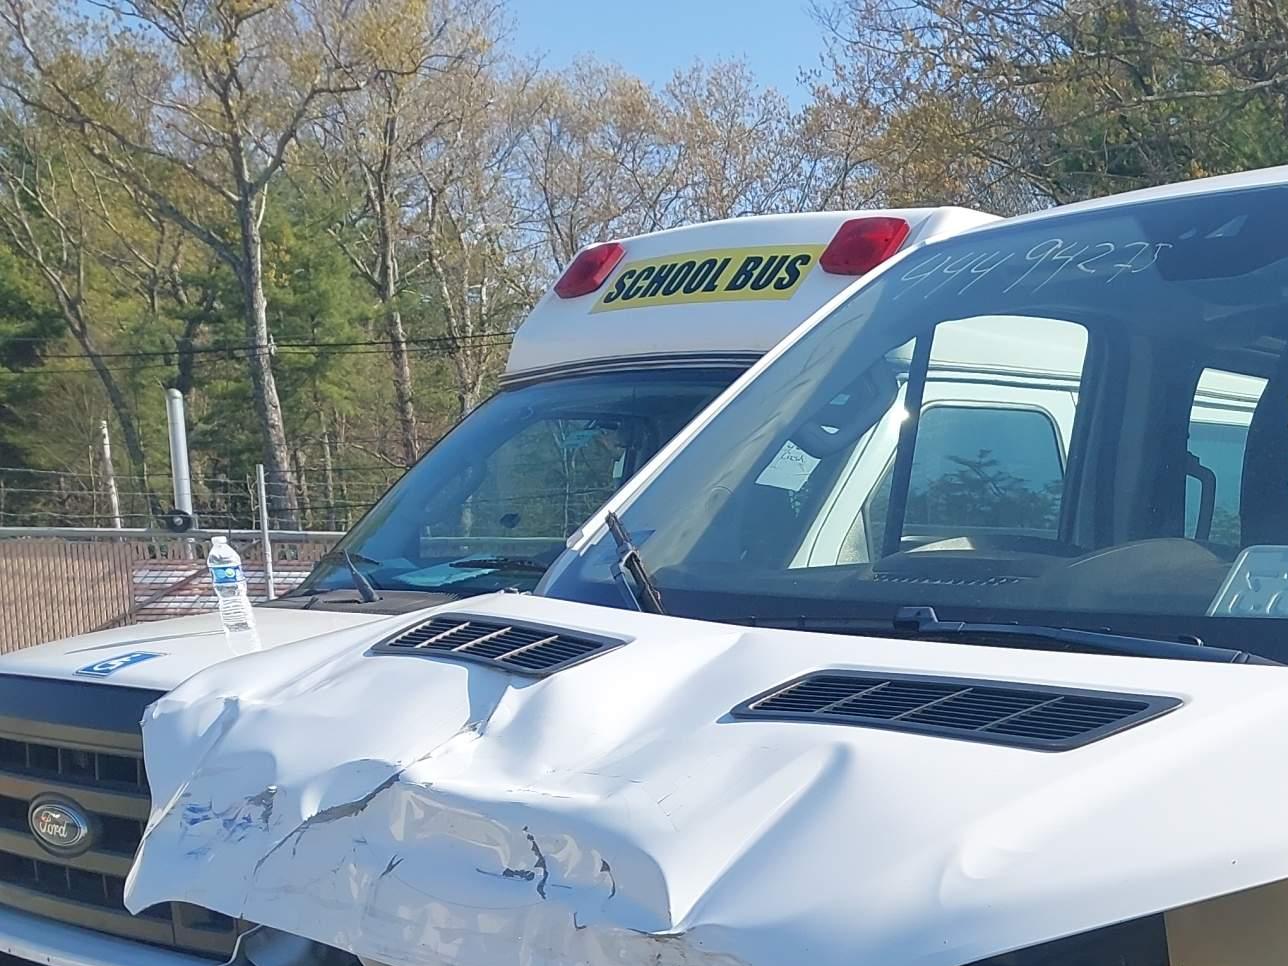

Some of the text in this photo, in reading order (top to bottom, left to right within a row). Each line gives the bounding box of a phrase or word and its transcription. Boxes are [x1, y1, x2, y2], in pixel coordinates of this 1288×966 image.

[603, 254, 812, 304] SCHOOL BUS
[38, 810, 68, 838] Ford
